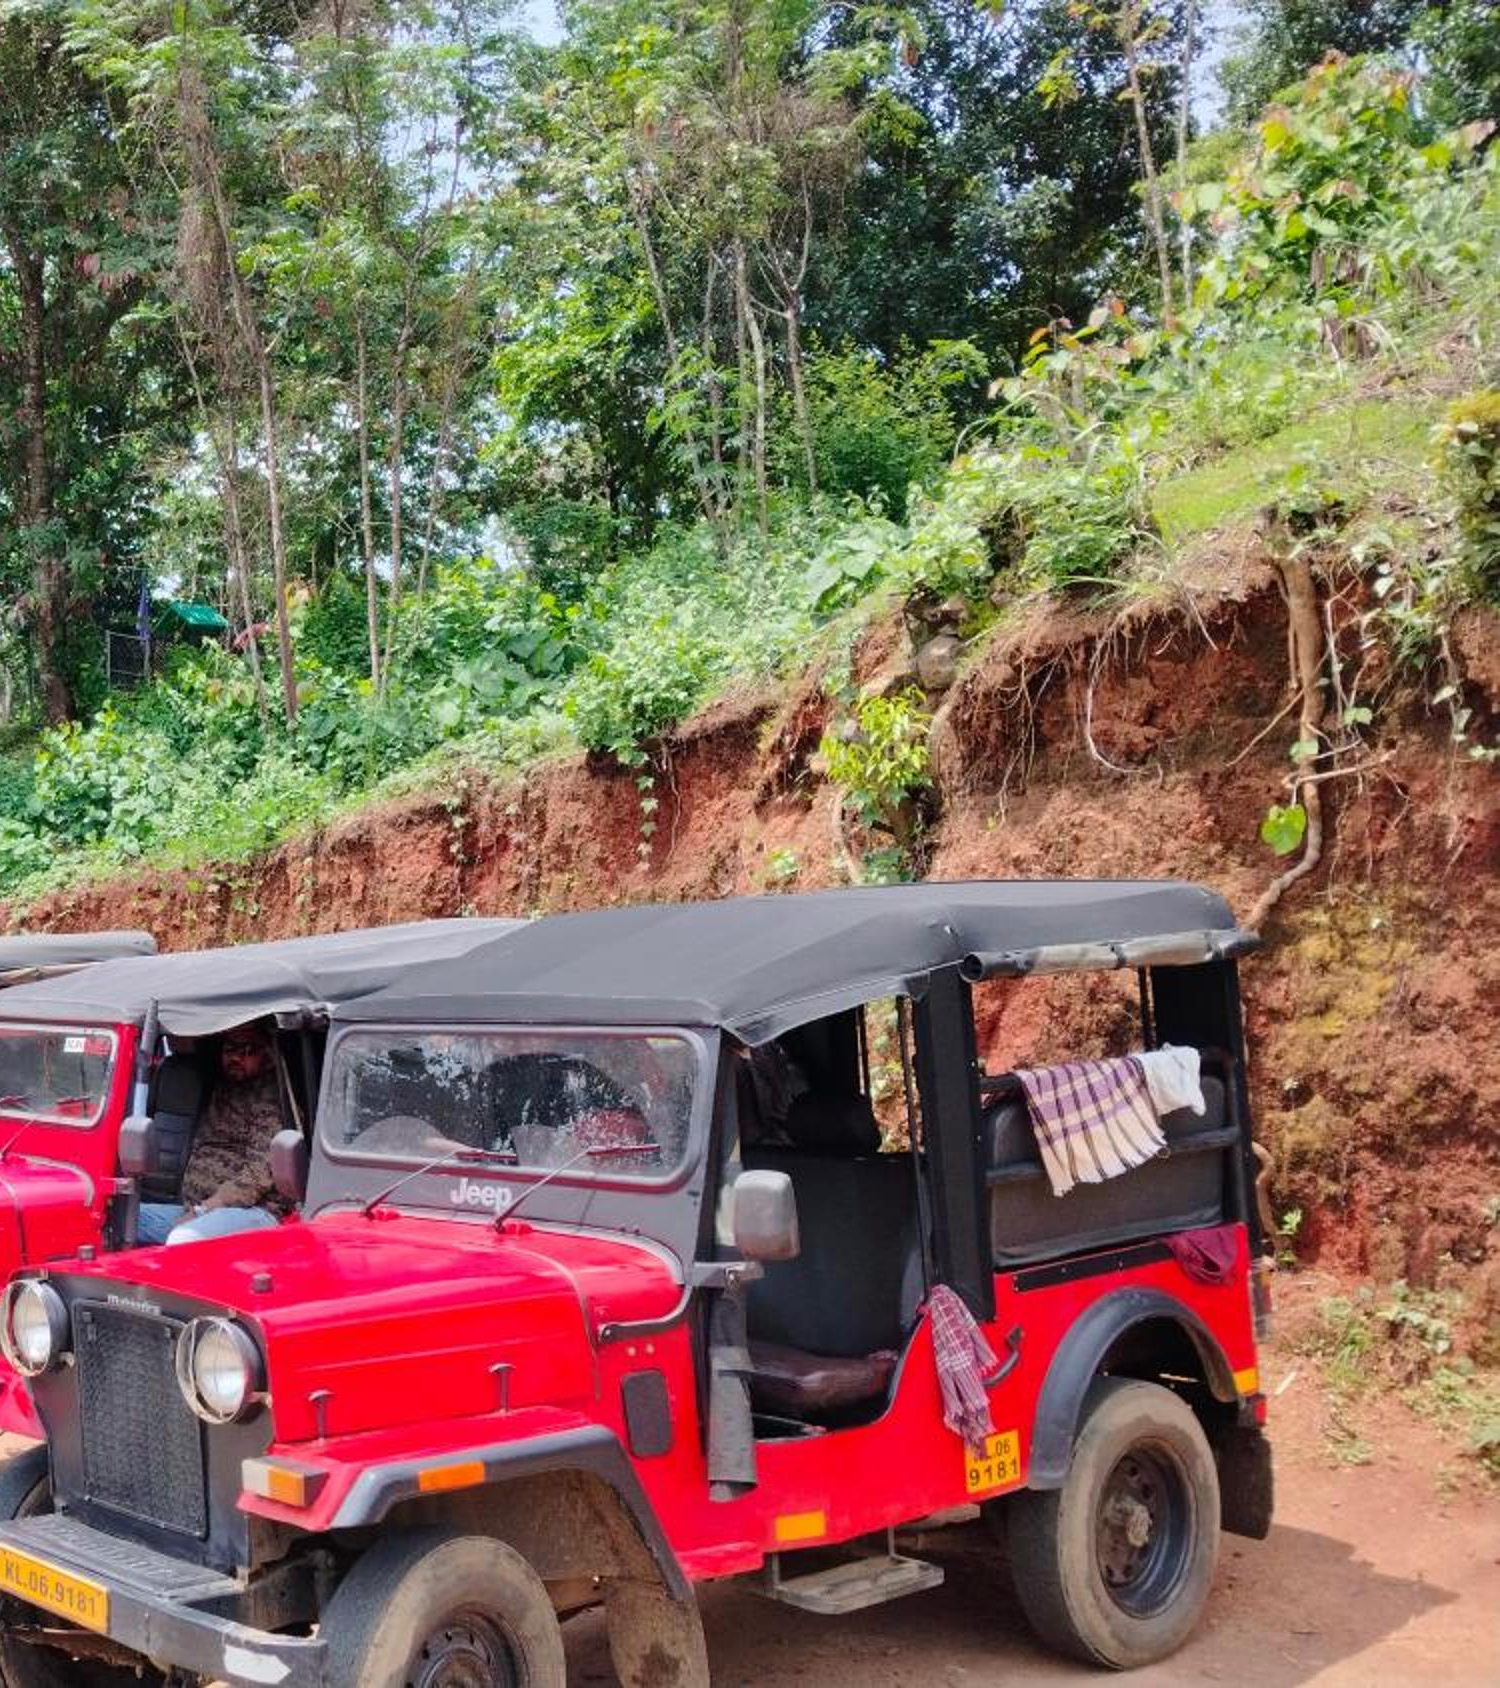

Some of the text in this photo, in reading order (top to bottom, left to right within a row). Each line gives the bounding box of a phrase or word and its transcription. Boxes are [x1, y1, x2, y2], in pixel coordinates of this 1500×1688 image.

[450, 1177, 513, 1211] Jeep
[969, 1456, 1018, 1487] 9181
[3, 1557, 96, 1617] KL.06.9181
